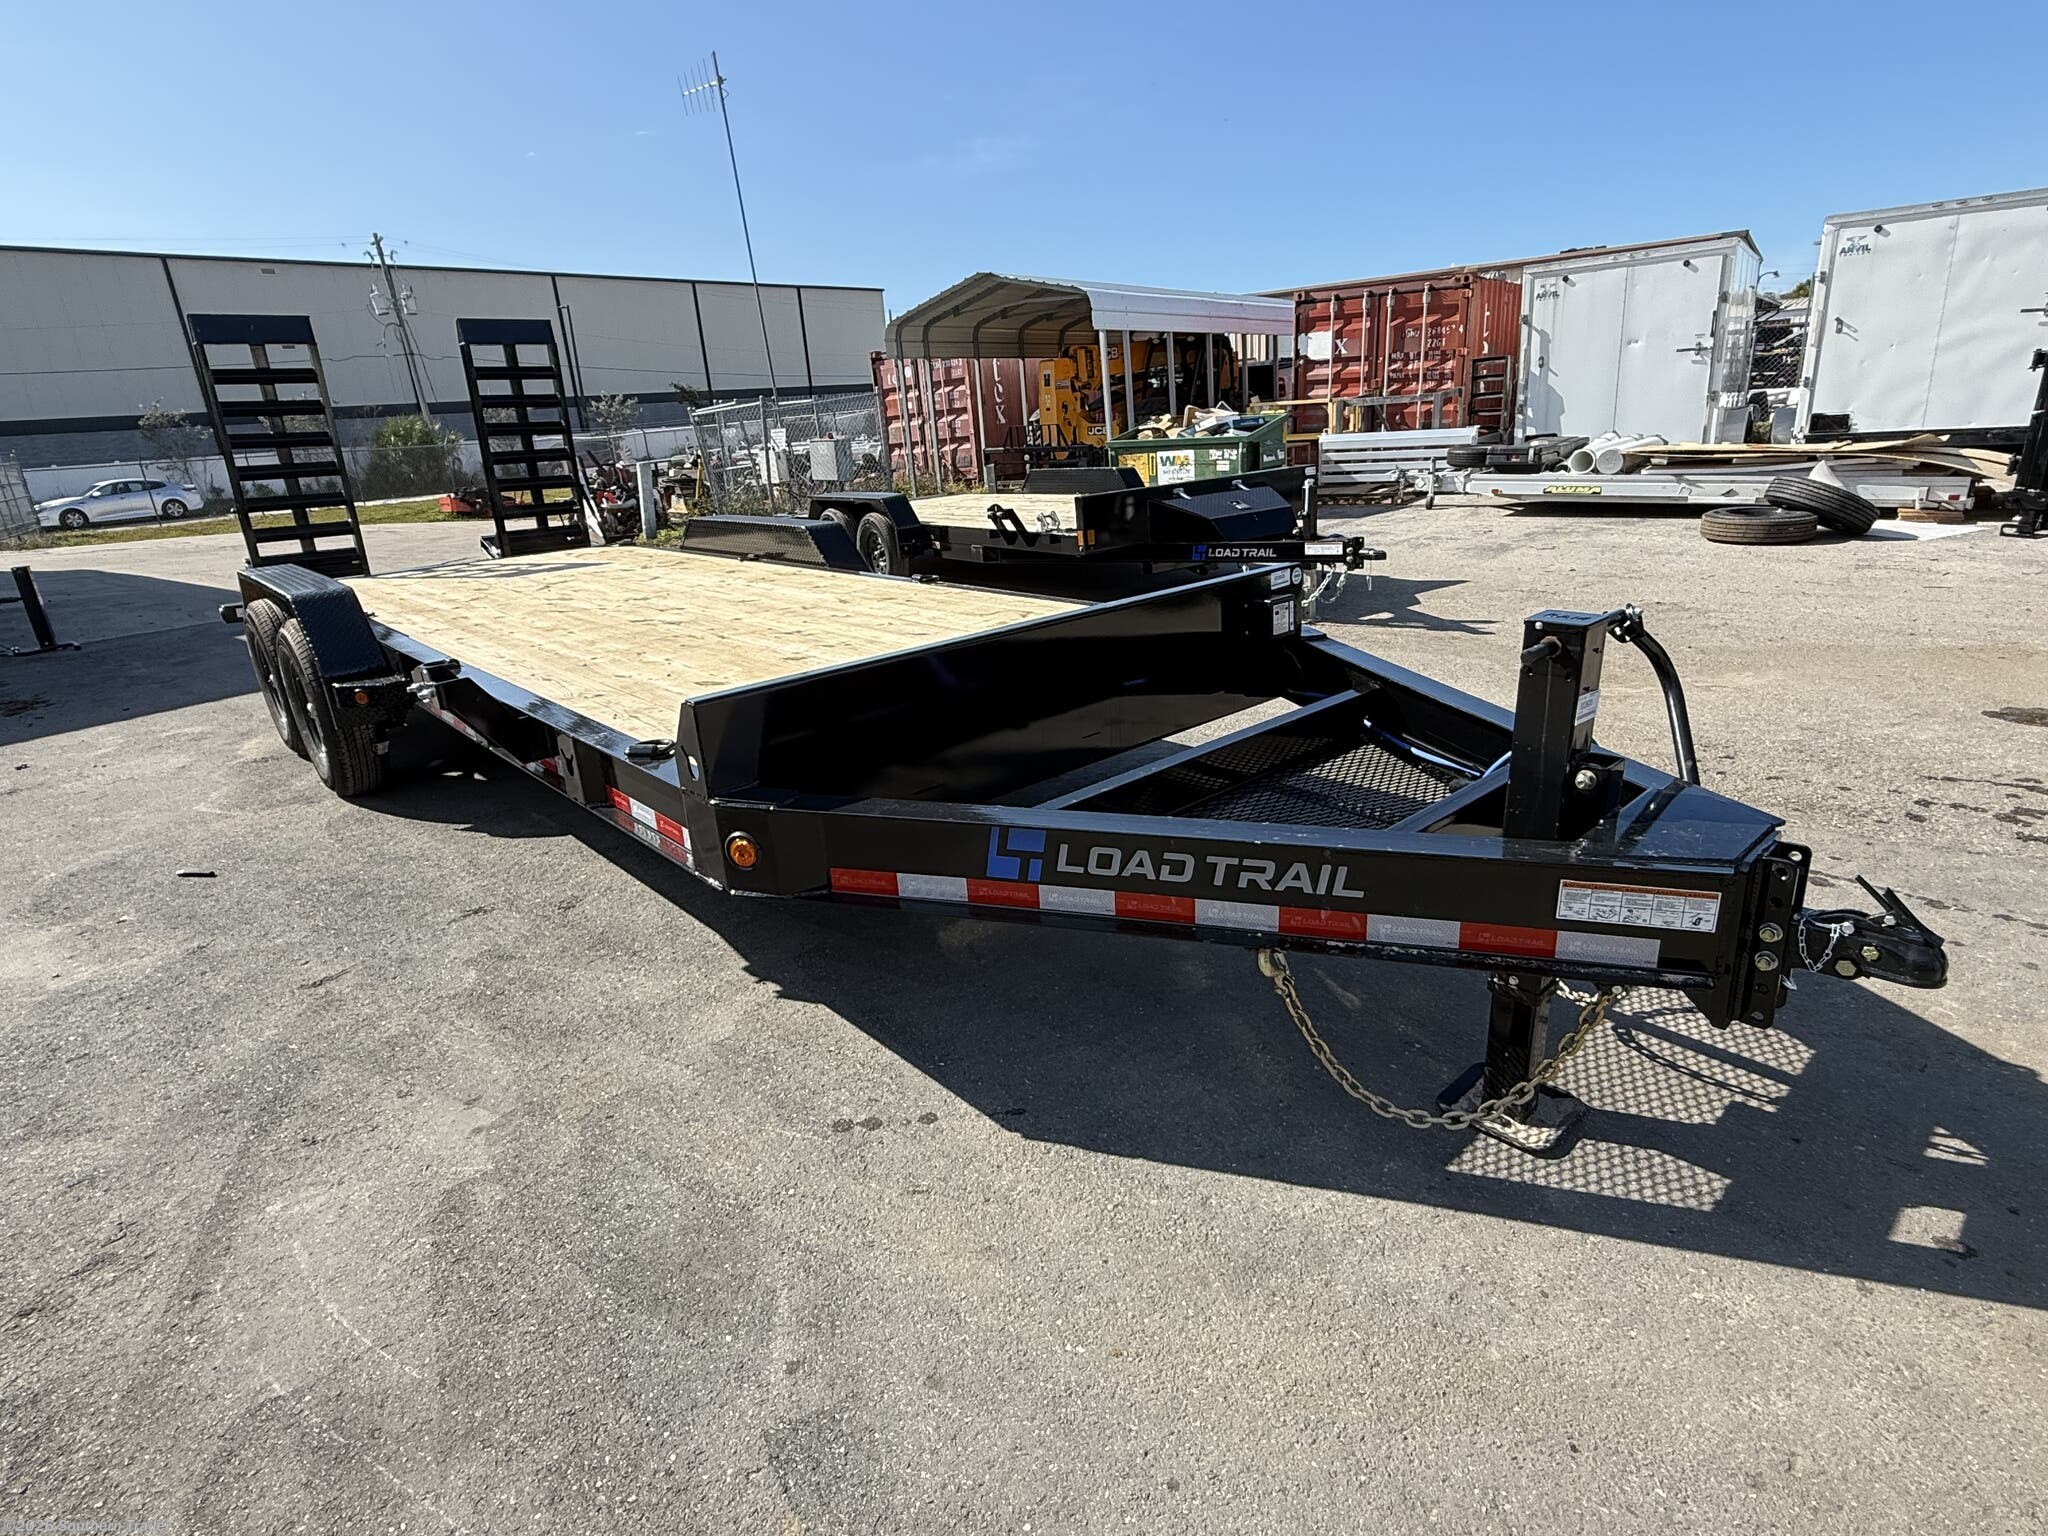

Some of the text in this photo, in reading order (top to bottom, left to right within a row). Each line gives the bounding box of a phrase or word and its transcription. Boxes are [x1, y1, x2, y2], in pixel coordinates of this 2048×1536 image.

[1543, 485, 1602, 494] ALUMA
[1208, 548, 1277, 557] LOAD TRAIL
[1056, 843, 1365, 898] LOAD TRAIL
